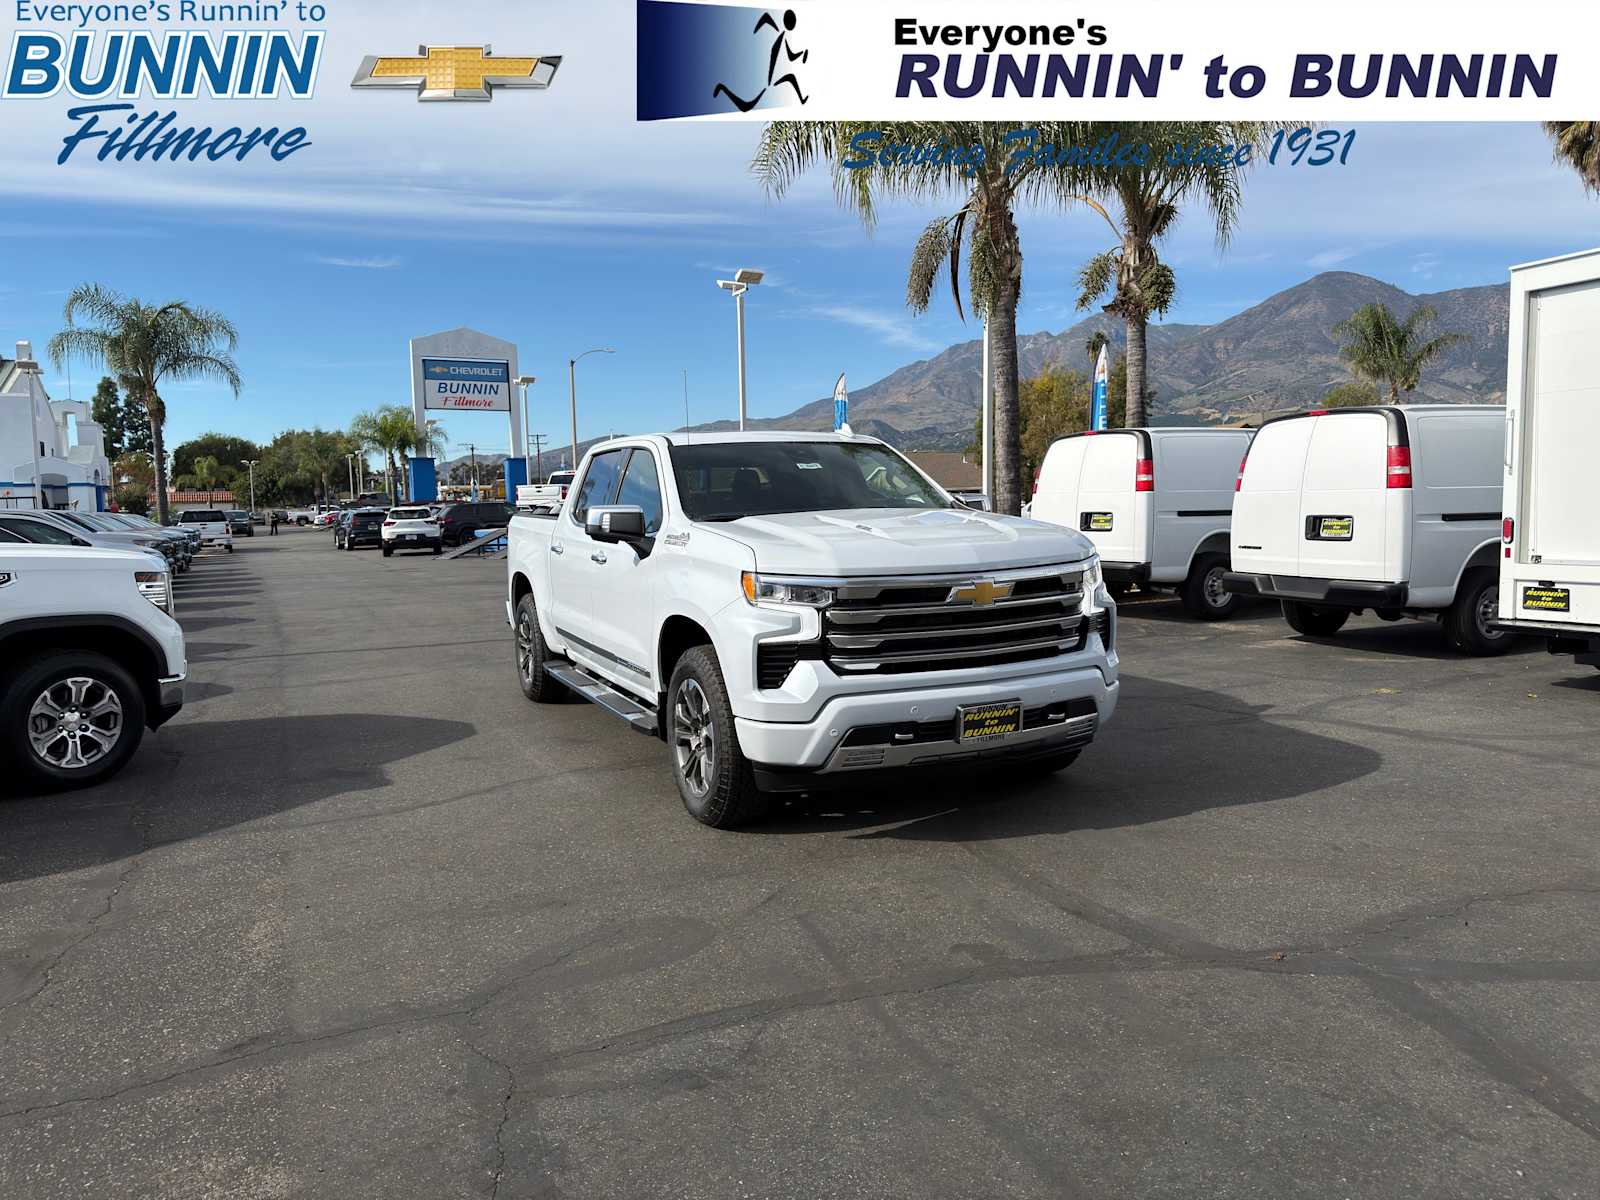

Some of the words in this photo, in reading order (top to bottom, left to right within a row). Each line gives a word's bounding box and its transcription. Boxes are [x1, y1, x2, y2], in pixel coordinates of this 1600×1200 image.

[449, 366, 504, 376] CHEVROLET
[437, 382, 500, 396] BUNNIN
[440, 395, 495, 408] Fillmore
[965, 723, 1016, 737] BUNNIN
